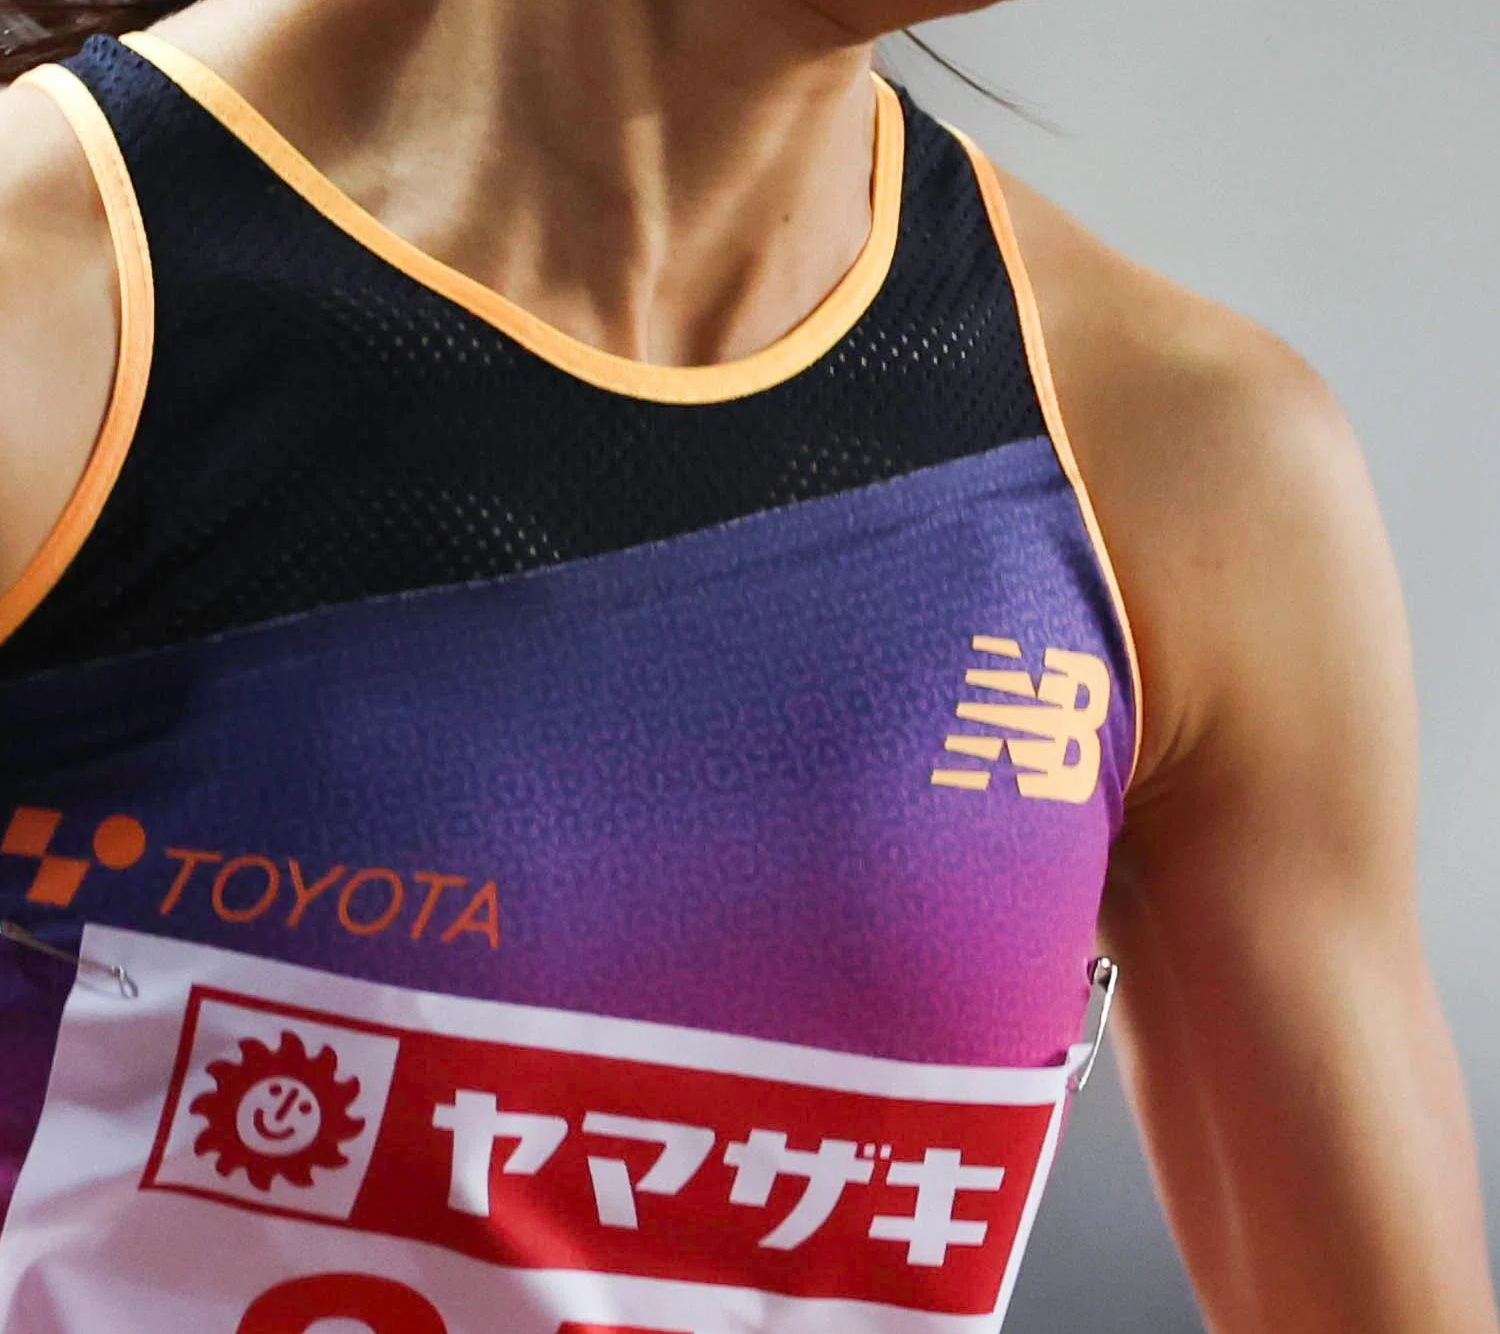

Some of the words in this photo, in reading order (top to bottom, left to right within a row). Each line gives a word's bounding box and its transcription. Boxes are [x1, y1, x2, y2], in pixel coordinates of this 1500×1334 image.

[157, 846, 500, 948] TOYOTA
[431, 1088, 1005, 1267] ヤマザキ
